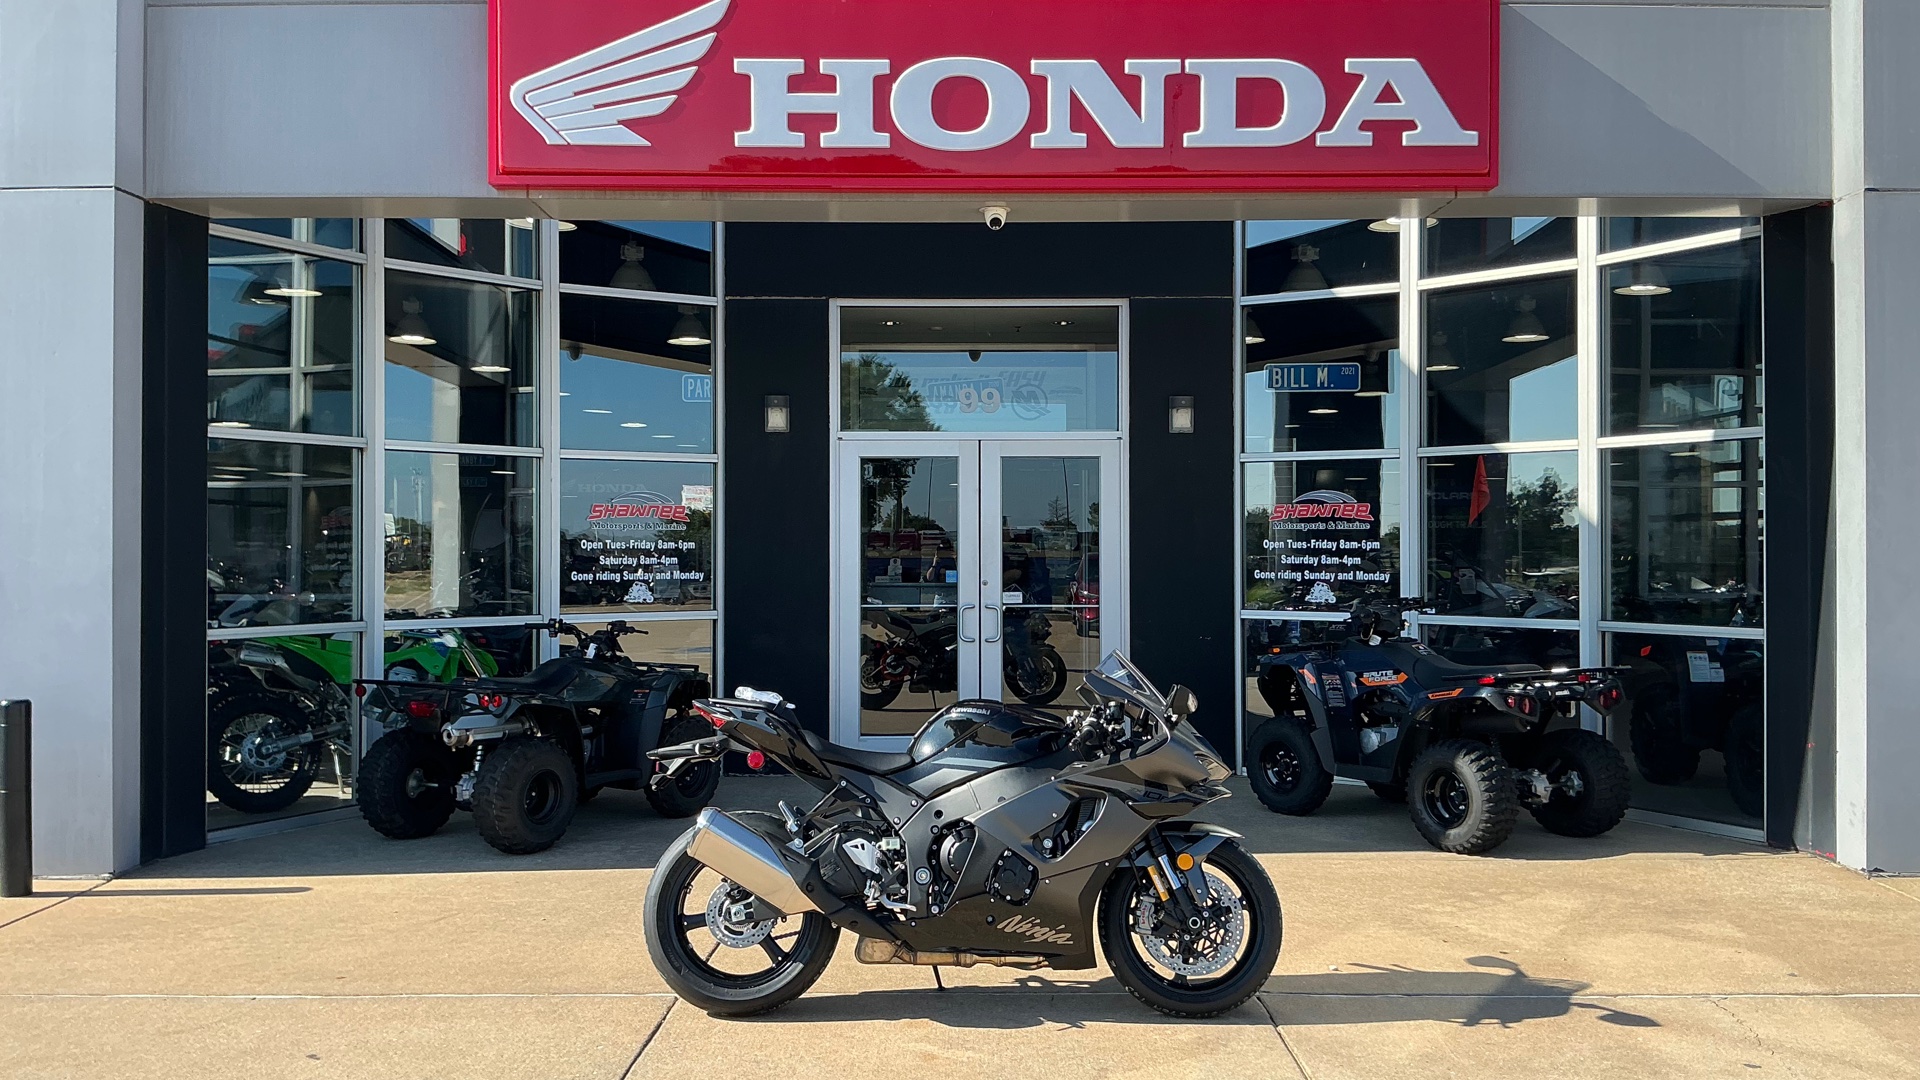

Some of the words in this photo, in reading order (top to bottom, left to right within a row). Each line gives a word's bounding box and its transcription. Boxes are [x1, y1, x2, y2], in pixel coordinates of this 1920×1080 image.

[732, 57, 1479, 151] HONDA
[1341, 366, 1355, 375] 2021
[1272, 367, 1309, 388] BILL
[1316, 367, 1334, 388] M.
[687, 378, 711, 398] PAR
[959, 388, 1001, 413] 99
[577, 483, 647, 493] HONDA
[591, 522, 644, 531] Motorsports
[655, 522, 687, 530] Marine
[1272, 521, 1326, 531] Motorsports
[1327, 521, 1336, 530] &
[1336, 521, 1370, 530] Marine
[580, 540, 603, 551] Open
[605, 539, 655, 552] Tues-Friday
[657, 539, 696, 552] 8am-6pm
[1263, 539, 1285, 550] Open
[1287, 539, 1337, 551] Tues-Friday
[1339, 539, 1381, 551] 8am-6pm
[599, 555, 637, 567] Saturday
[639, 555, 678, 567] 8am-4pm
[1280, 555, 1318, 566] Saturday
[1320, 555, 1361, 566] 8am-4pm
[571, 571, 594, 581] Gone
[596, 571, 621, 582] riding
[623, 571, 654, 582] Sunday
[655, 571, 670, 580] and
[673, 571, 704, 582] Monday
[1254, 570, 1275, 580] Gone
[1277, 570, 1302, 581] riding
[1304, 570, 1335, 582] Sunday
[1337, 570, 1354, 580] and
[1356, 570, 1390, 583] Monday
[1363, 670, 1394, 678] BRUTE
[950, 707, 991, 716] Kawasaki
[996, 914, 1074, 945] Ninja
